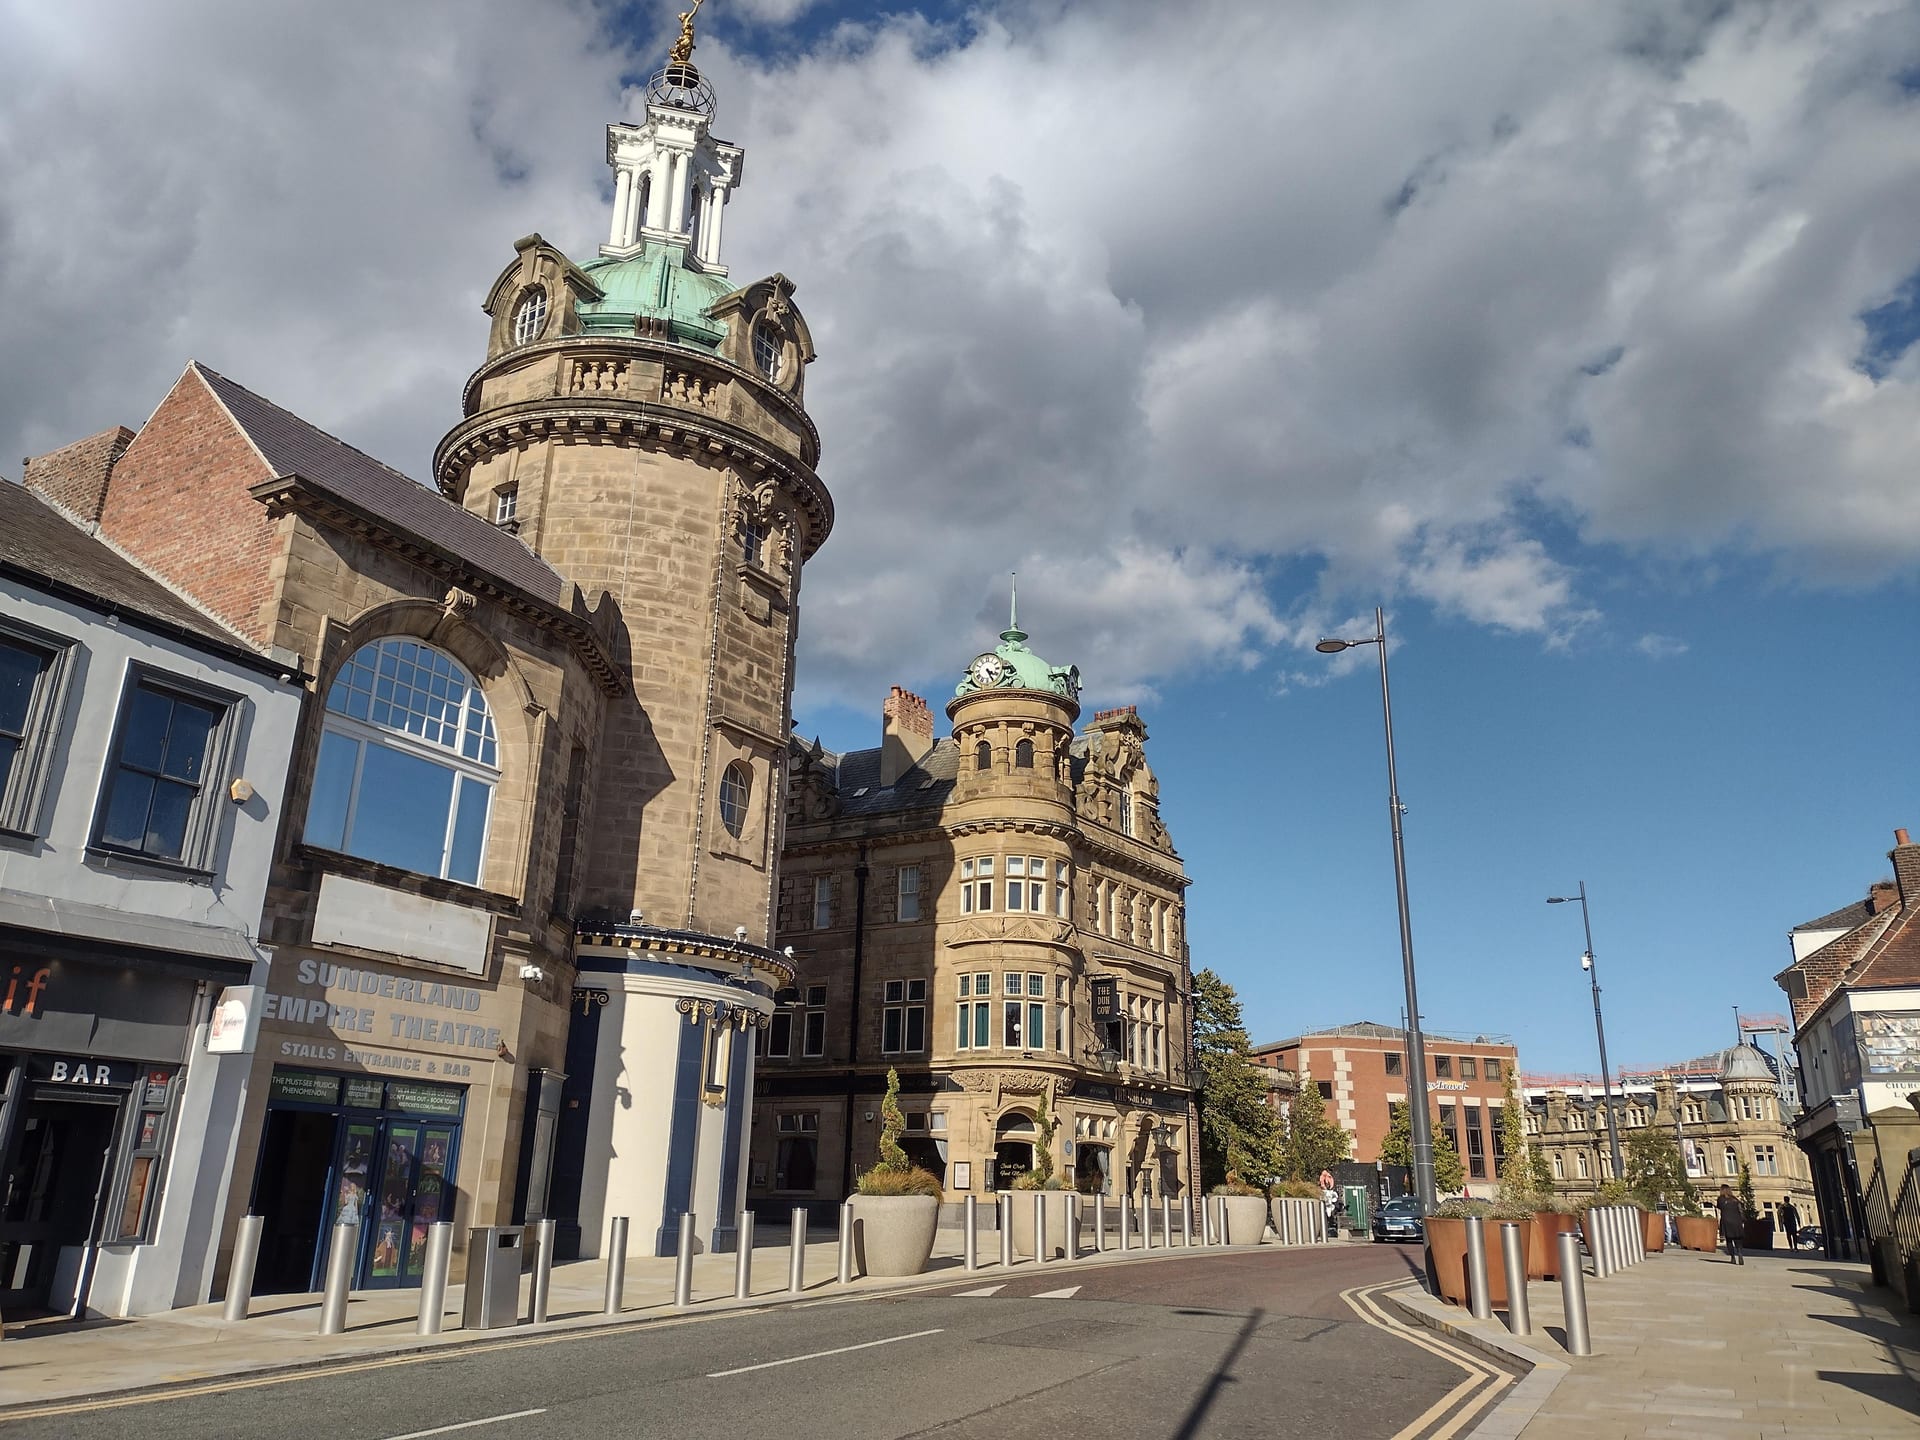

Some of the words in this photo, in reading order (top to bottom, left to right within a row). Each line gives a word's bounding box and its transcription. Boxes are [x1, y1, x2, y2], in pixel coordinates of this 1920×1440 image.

[297, 958, 482, 1012] SUNDERLAND
[1097, 986, 1111, 995] THE
[1097, 996, 1110, 1005] DUN
[1096, 1006, 1111, 1015] COW
[261, 993, 375, 1033] EMPIRE
[390, 1013, 501, 1050] THEATRE
[280, 1041, 337, 1060] STALLS
[343, 1049, 421, 1072] ENTRANCE
[426, 1061, 437, 1074] &
[443, 1062, 471, 1077] BAR
[51, 1061, 110, 1085] BAR
[272, 1076, 285, 1085] THE
[313, 1080, 340, 1090] MUSICAL
[1436, 1080, 1469, 1092] Travel
[281, 1086, 327, 1097] PHENOMENON
